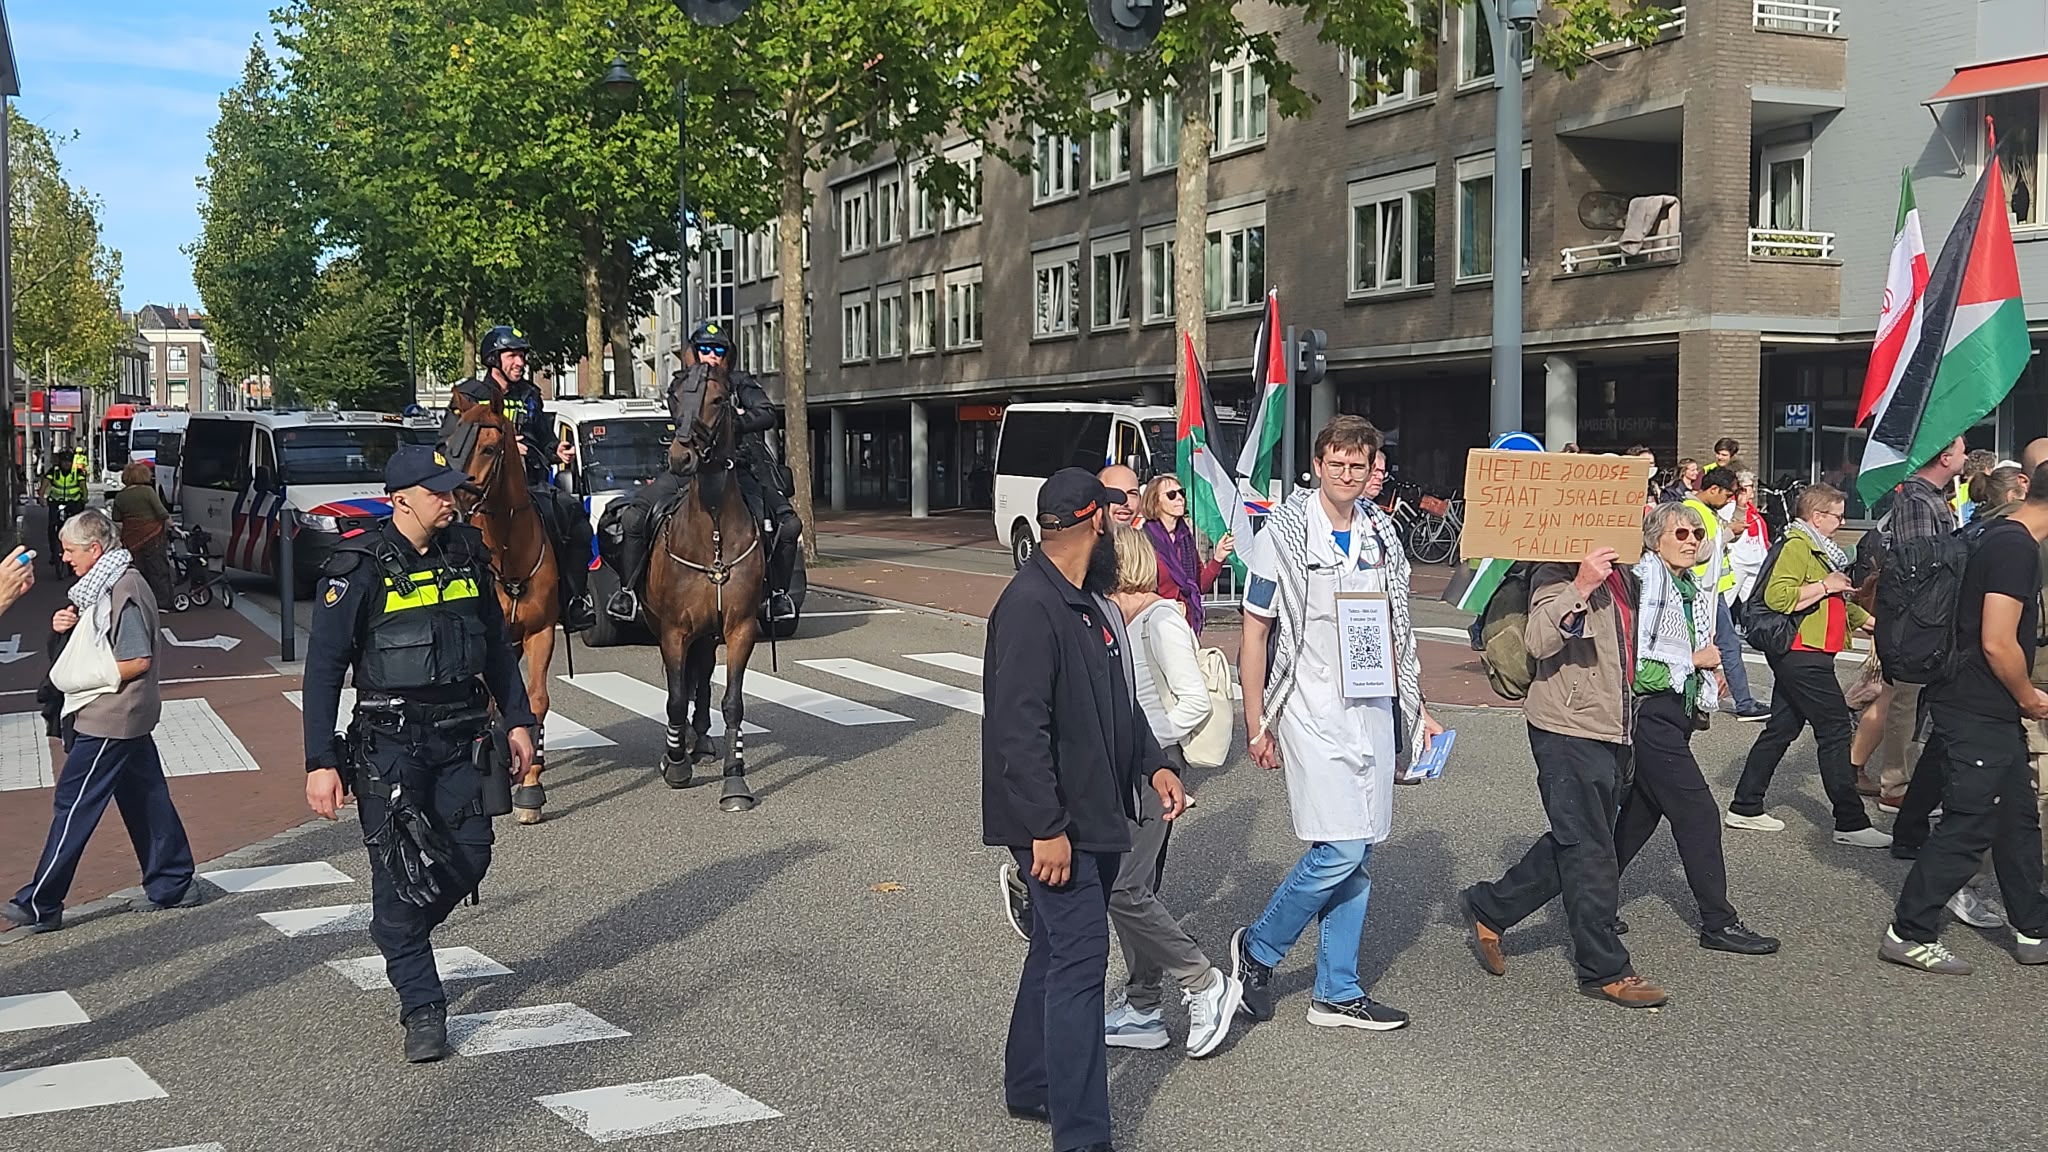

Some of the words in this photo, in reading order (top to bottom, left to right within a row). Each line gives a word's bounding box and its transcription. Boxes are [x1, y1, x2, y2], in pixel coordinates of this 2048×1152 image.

[112, 421, 122, 431] 45
[1578, 417, 1657, 432] AMBERTUSHOF
[1478, 457, 1523, 482] HET
[1529, 461, 1551, 481] DE
[1560, 463, 1631, 483] JOODSE
[1480, 485, 1542, 507] STAAT
[1626, 491, 1645, 505] OP
[1572, 513, 1638, 528] MOREEL
